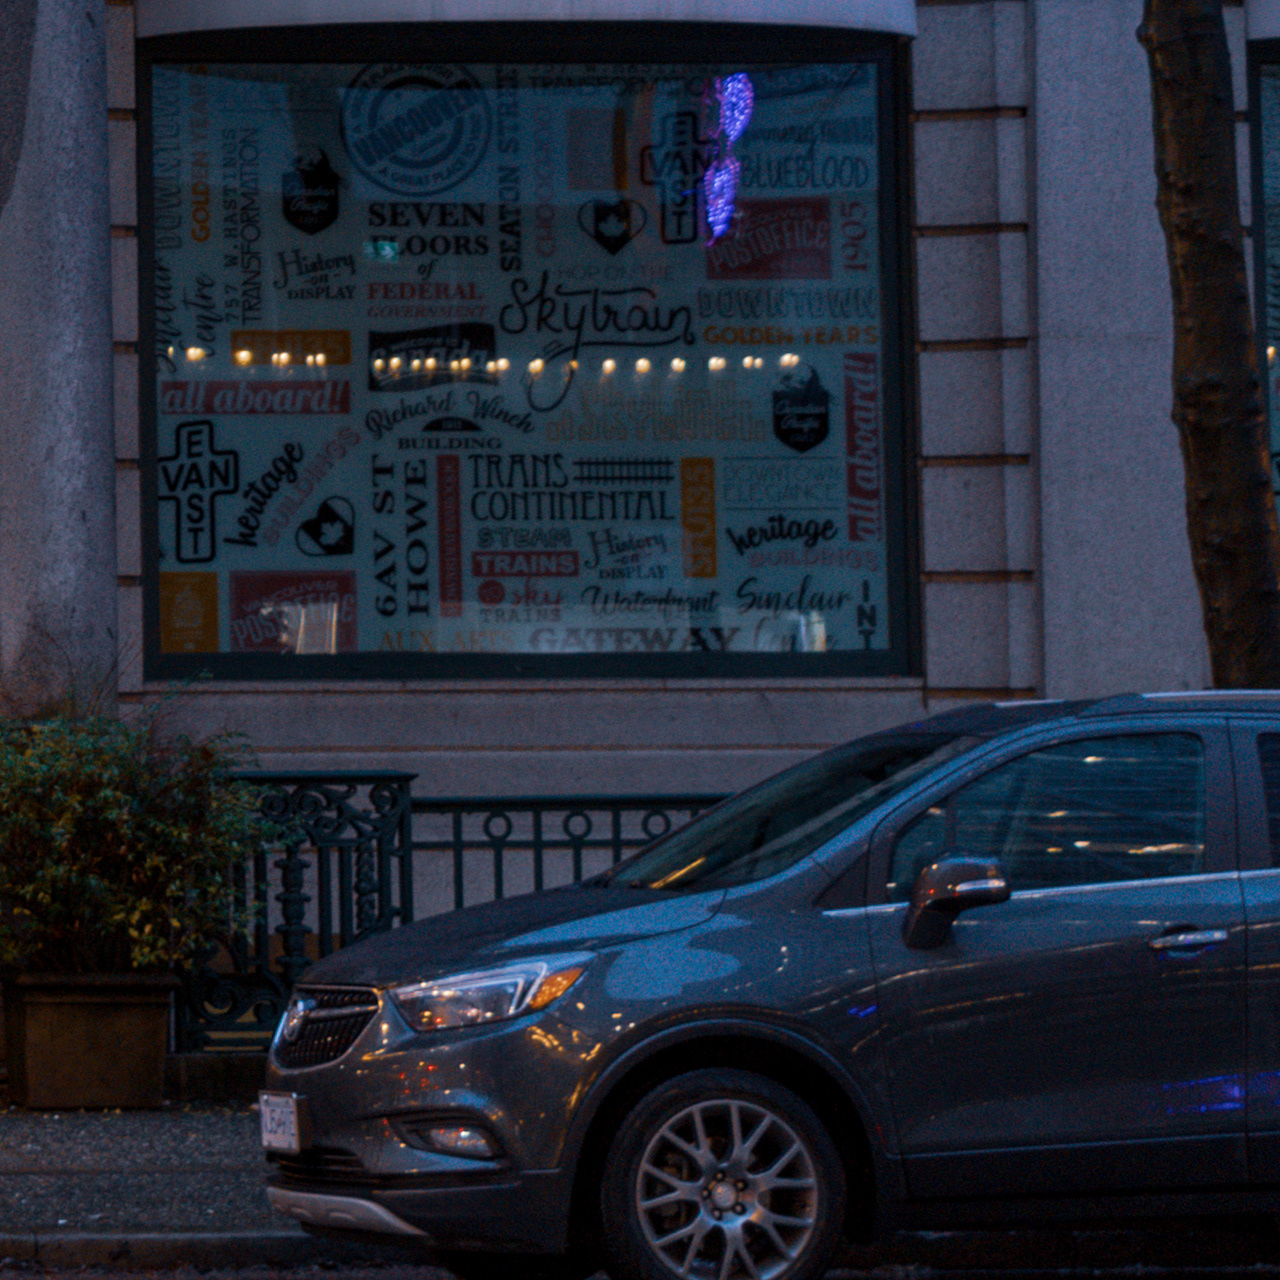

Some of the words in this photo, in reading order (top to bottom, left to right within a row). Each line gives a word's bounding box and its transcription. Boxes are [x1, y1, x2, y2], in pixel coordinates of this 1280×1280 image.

[241, 126, 263, 325] TRANSFORMATION
[368, 202, 487, 228] SEVEN
[498, 164, 522, 272] SEATON
[369, 234, 489, 256] FLOORS
[273, 247, 357, 289] History
[417, 258, 438, 281] of
[287, 285, 357, 301] DISPLAY
[367, 281, 485, 300] FEDERAL
[499, 270, 695, 412] Skytrain
[704, 325, 794, 345] GOLDEN
[803, 325, 880, 345] YEARS
[163, 381, 207, 413] all
[365, 389, 456, 440] Richard
[466, 389, 536, 435] Winch
[397, 437, 503, 451] BUILDING
[161, 461, 230, 493] VAN
[467, 452, 570, 489] TRANS
[223, 441, 305, 548] heritage
[470, 490, 675, 521] CONTINENTAL
[405, 458, 430, 617] HOWE
[477, 526, 573, 549] STEAM
[724, 513, 839, 557] heritage
[476, 554, 576, 574] TRAINS
[735, 573, 853, 620] Sinclair
[528, 626, 741, 652] GATEWAY
